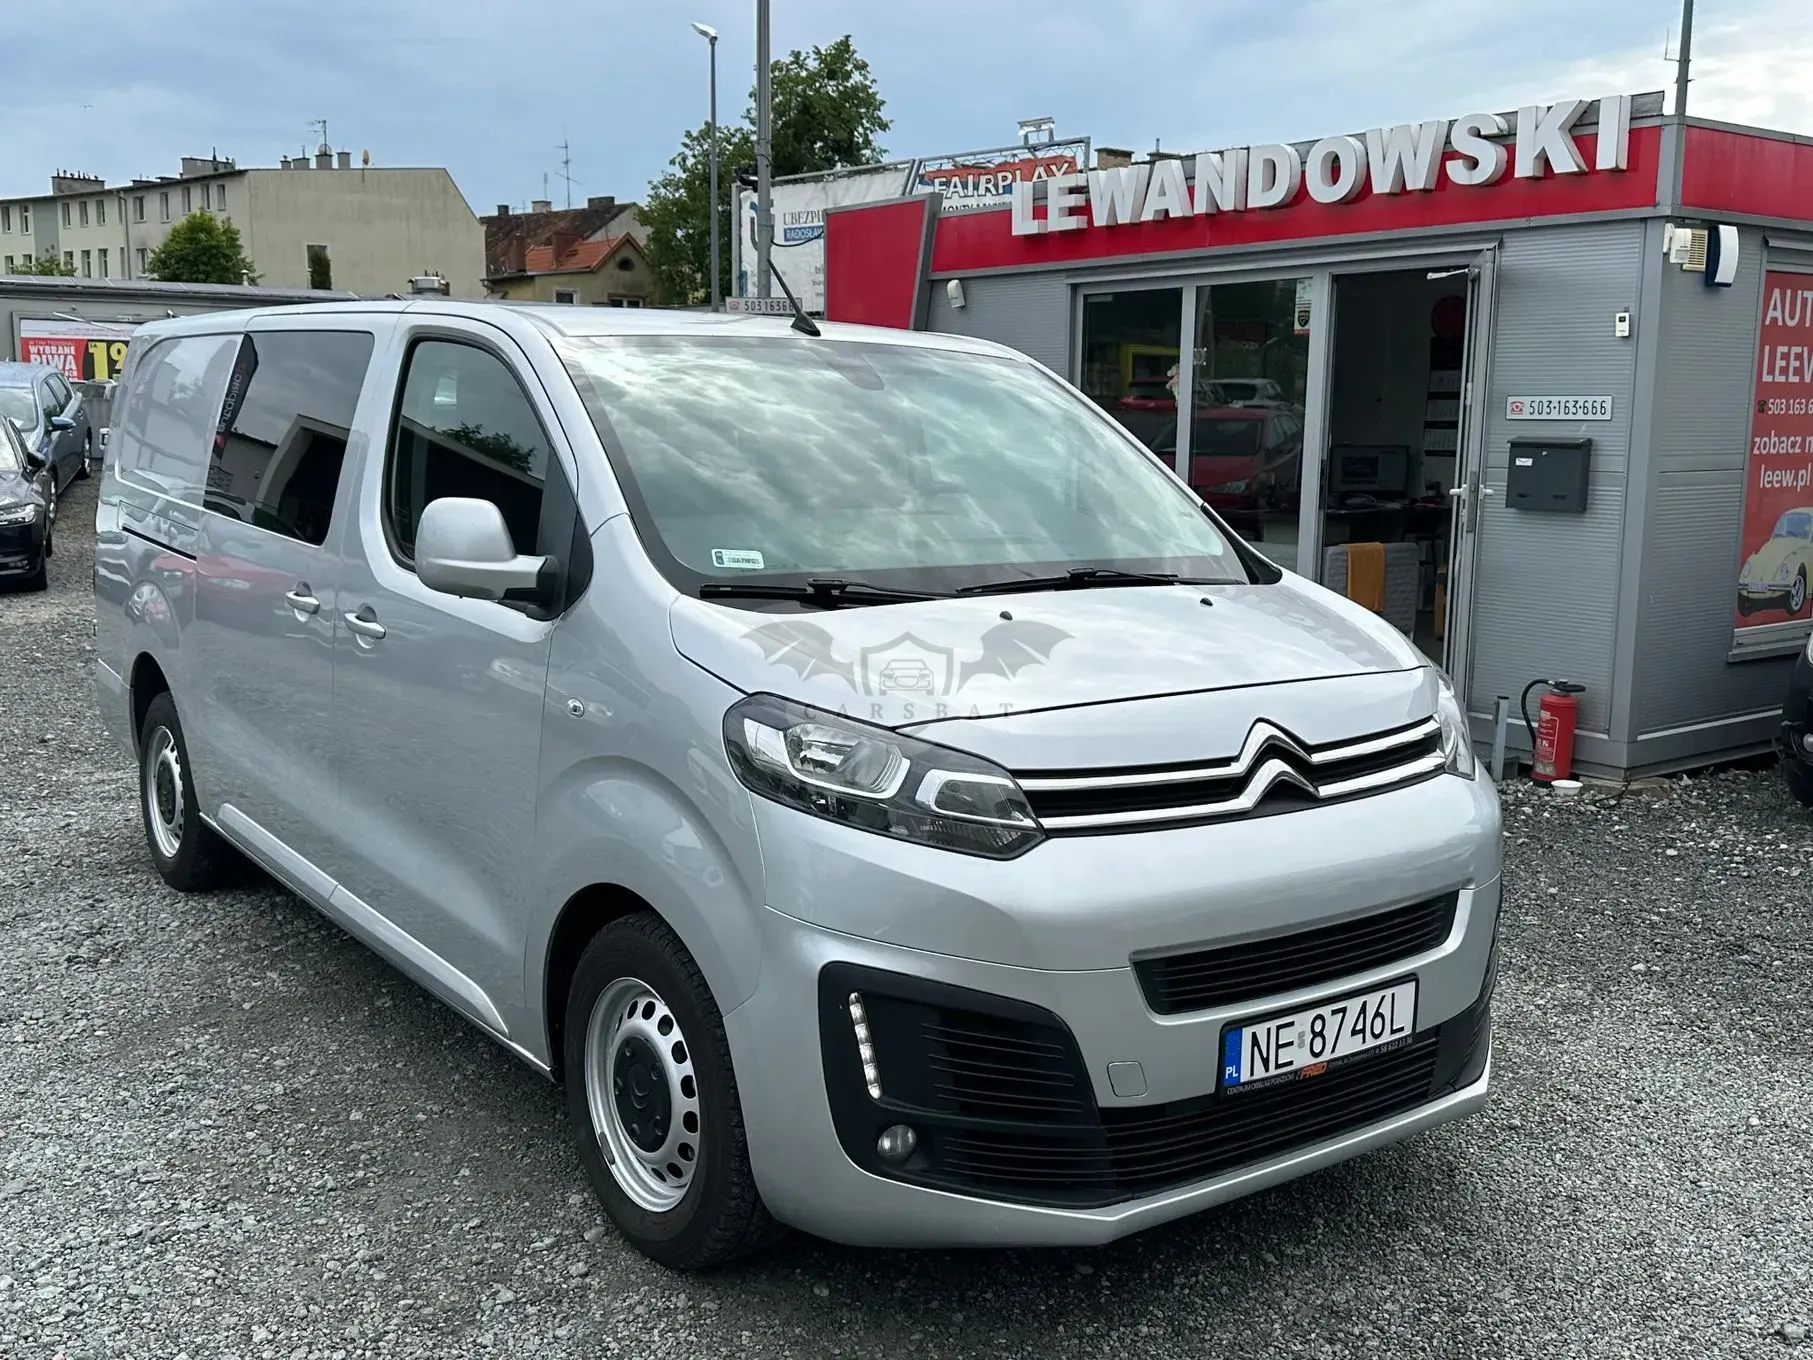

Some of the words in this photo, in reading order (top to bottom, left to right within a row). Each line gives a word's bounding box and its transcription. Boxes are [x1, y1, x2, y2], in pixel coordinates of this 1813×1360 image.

[1011, 95, 1631, 236] LEWANDOWSKI
[29, 345, 76, 355] WYBRANE
[1768, 399, 1786, 414] 503
[1788, 399, 1806, 414] 163
[1753, 430, 1802, 454] zobacz
[1760, 463, 1811, 493] leew.pl
[1250, 1021, 1295, 1077] NE
[1309, 992, 1405, 1059] 8746L
[1225, 1066, 1238, 1079] PL
